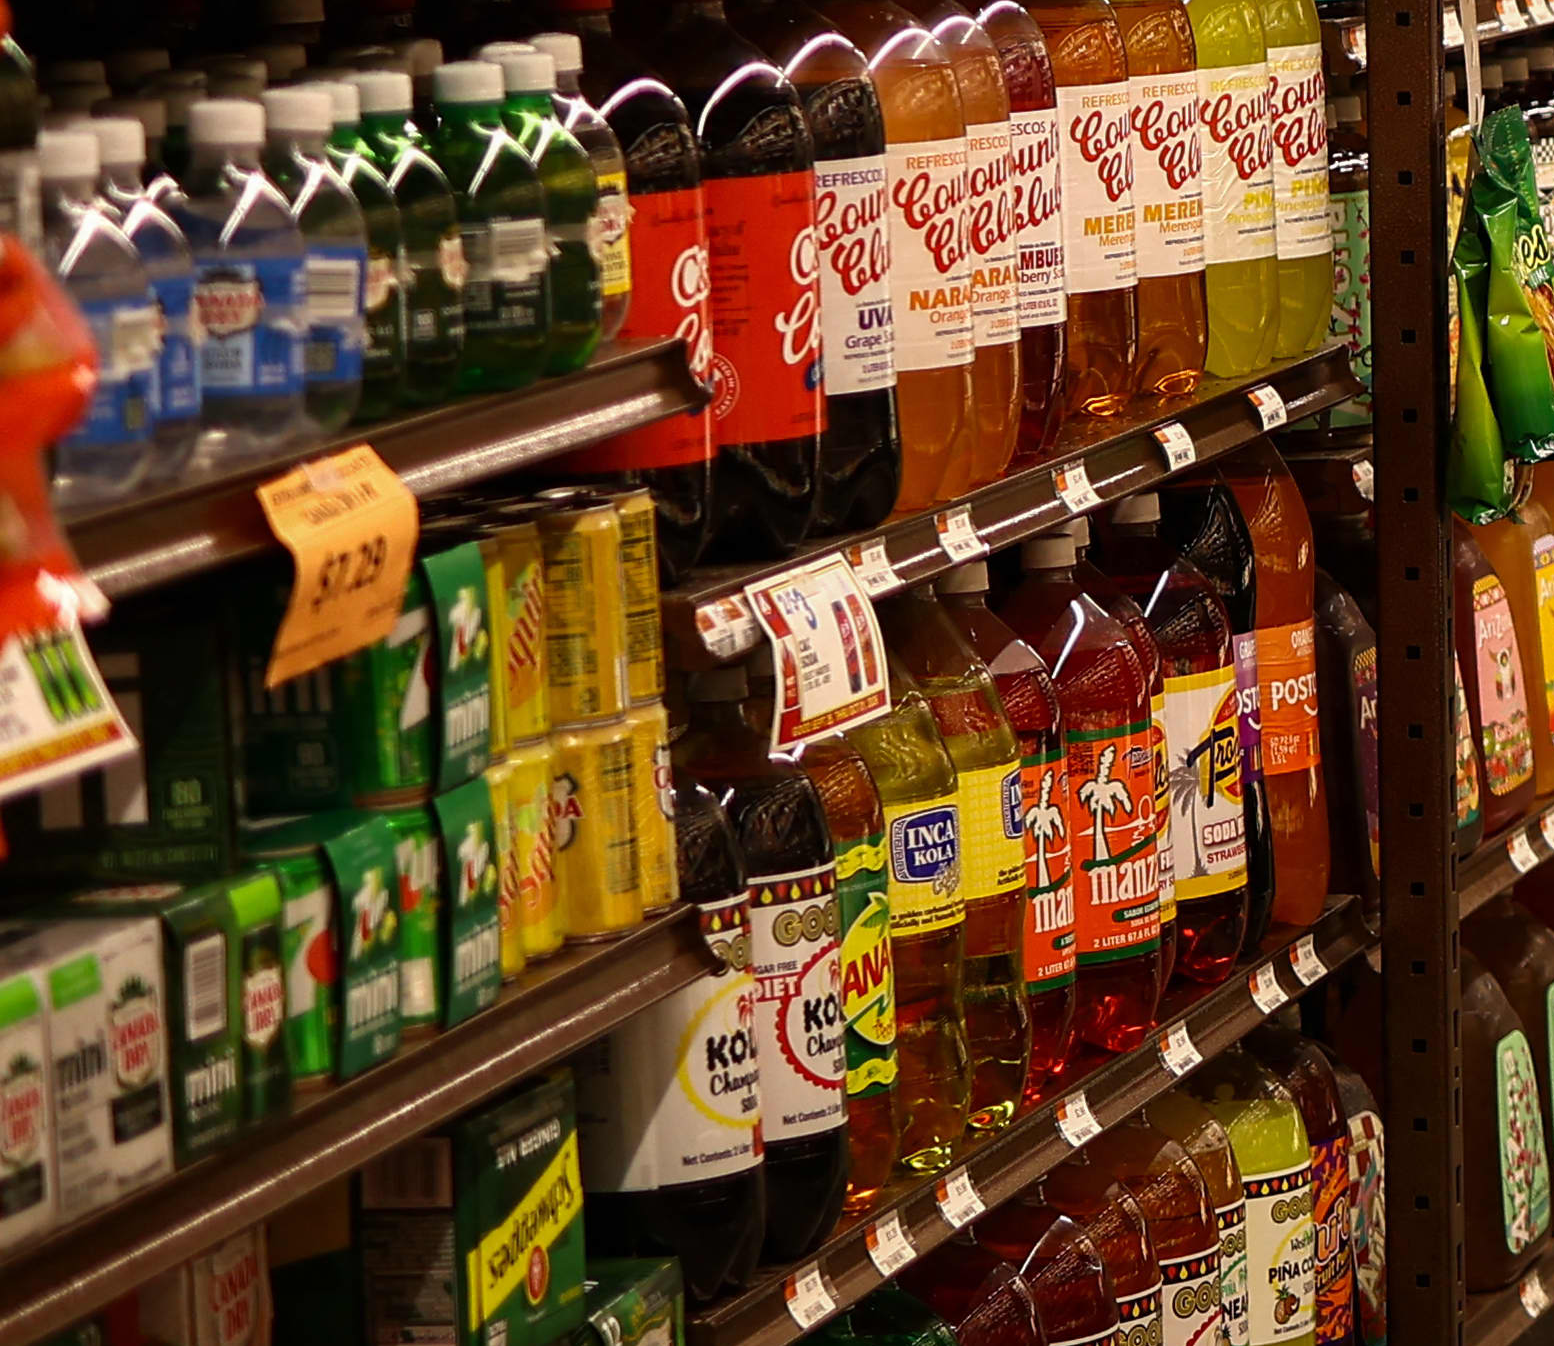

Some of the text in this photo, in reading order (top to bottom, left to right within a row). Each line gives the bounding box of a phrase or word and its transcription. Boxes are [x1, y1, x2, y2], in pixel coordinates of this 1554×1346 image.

[970, 135, 1009, 151] RESCOS
[1084, 211, 1135, 236] MERE
[858, 305, 893, 330] UVA
[845, 334, 881, 351] Grape
[907, 819, 955, 850] INCA
[1203, 824, 1237, 846] SODA
[914, 845, 954, 867] KOLA
[1094, 939, 1099, 948] 2
[1103, 933, 1126, 946] LITER
